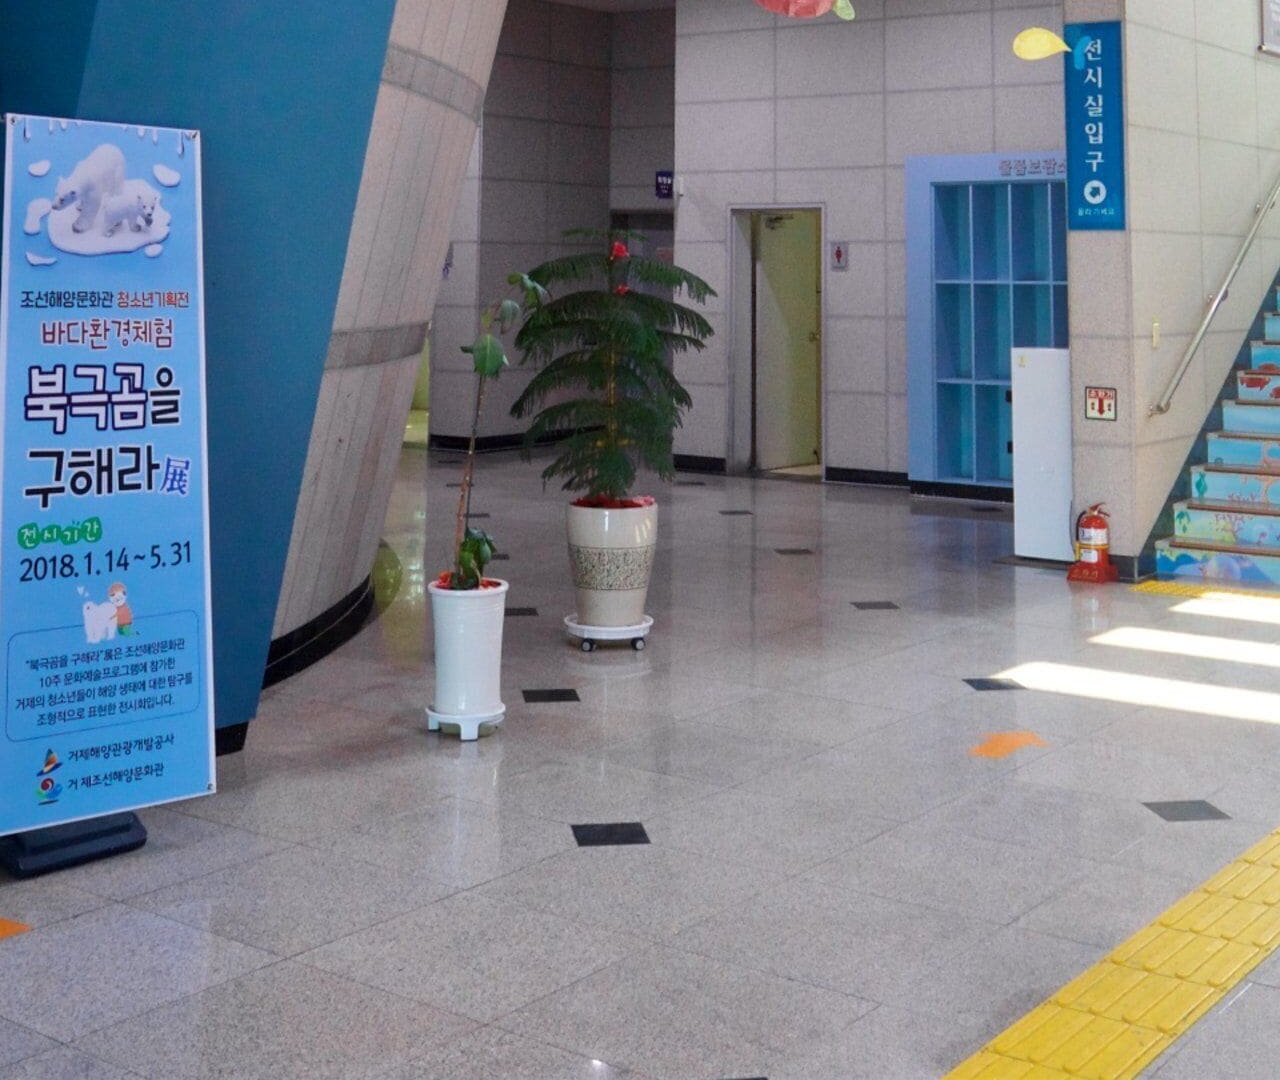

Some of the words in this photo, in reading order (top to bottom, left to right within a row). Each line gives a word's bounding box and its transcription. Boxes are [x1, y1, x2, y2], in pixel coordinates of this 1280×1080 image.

[1084, 39, 1104, 172] 전시실입구
[20, 290, 114, 309] 조선해양문화관
[117, 291, 189, 309] 청소년기획전
[42, 318, 173, 350] 바다환경체험
[24, 362, 181, 435] 북극곰을
[20, 520, 99, 548] 전시기간
[125, 638, 185, 658] 조선해양문화관
[40, 673, 61, 688] 10주
[16, 695, 45, 711] 거제의
[48, 687, 96, 707] 청소년들이
[98, 684, 117, 697] 해양
[37, 707, 85, 726] 조형적으로
[68, 733, 175, 761] 거제해양관광개발공사
